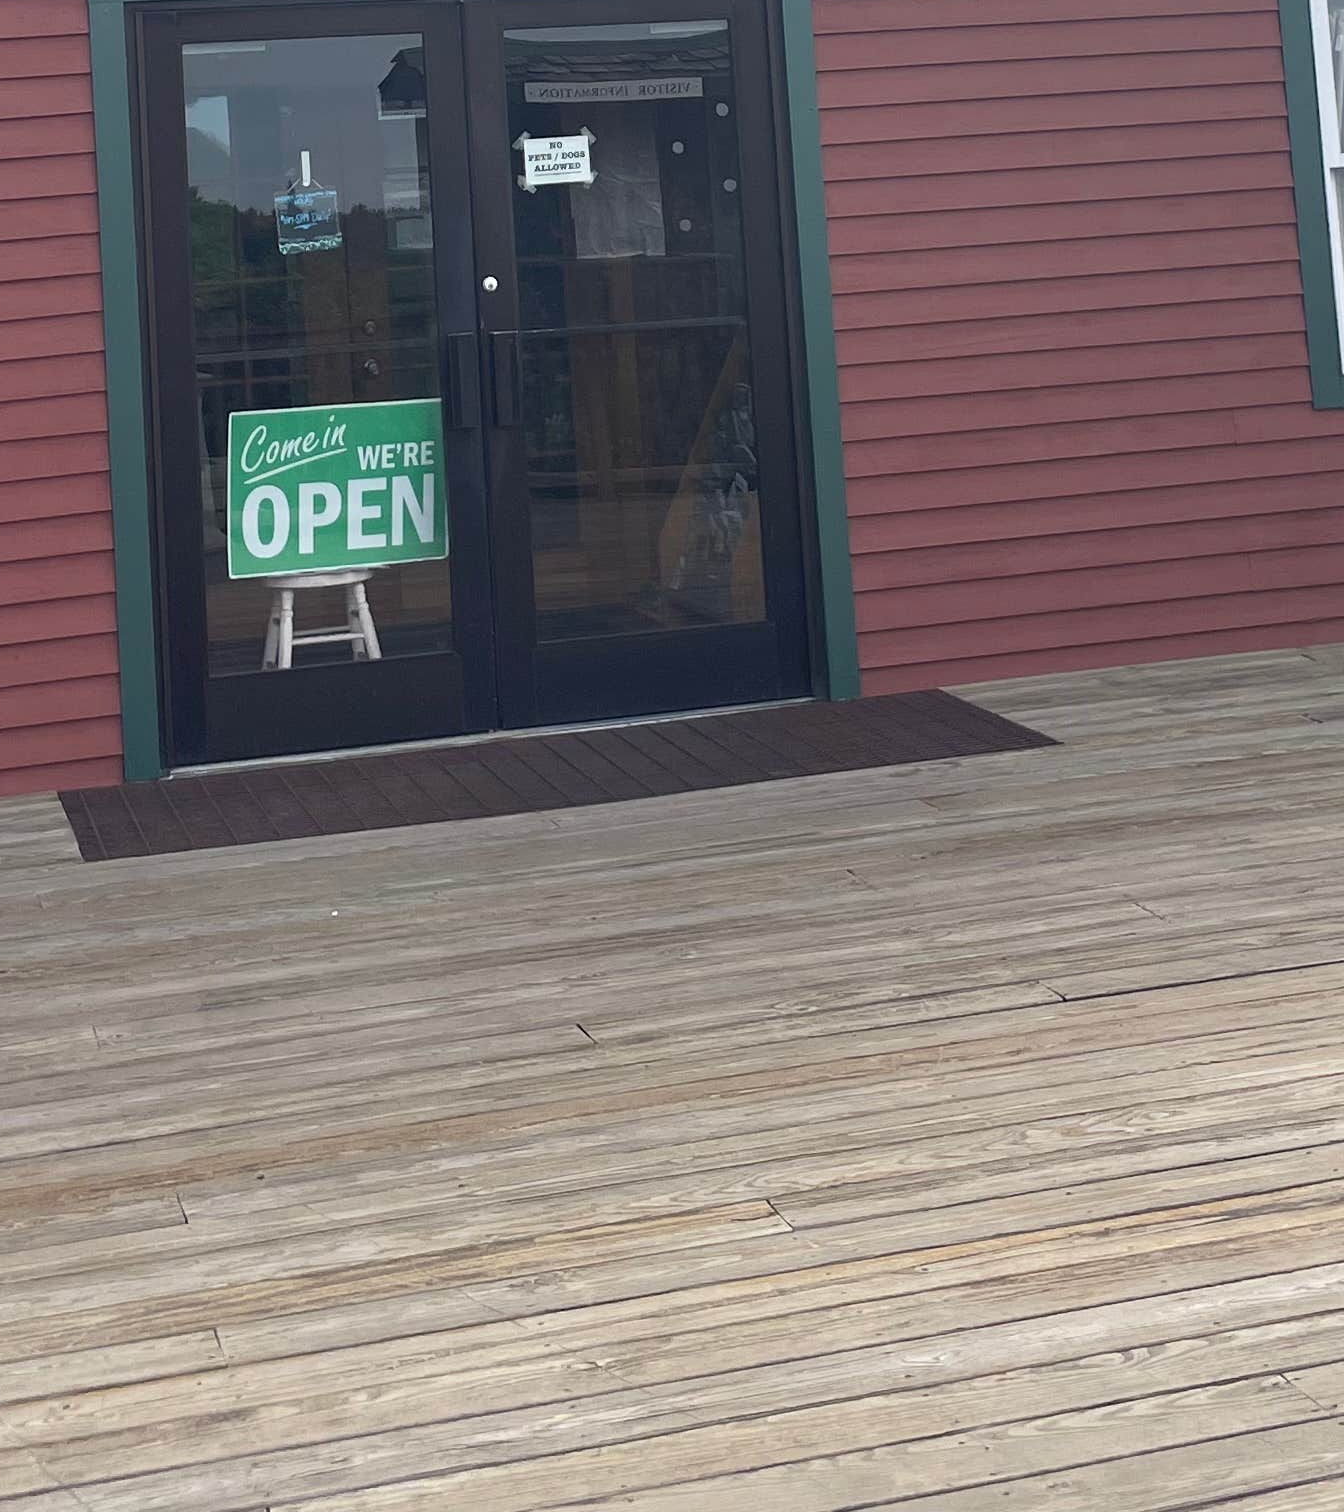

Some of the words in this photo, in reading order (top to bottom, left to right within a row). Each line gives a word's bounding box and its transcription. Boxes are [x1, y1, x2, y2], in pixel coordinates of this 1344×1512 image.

[549, 141, 563, 149] NO
[528, 153, 553, 162] PETS
[561, 151, 586, 160] DOGS
[534, 162, 582, 172] ALLOWED
[240, 425, 319, 473] Come
[322, 414, 347, 449] in
[357, 440, 435, 471] WE'RE
[241, 473, 435, 559] OPEN
